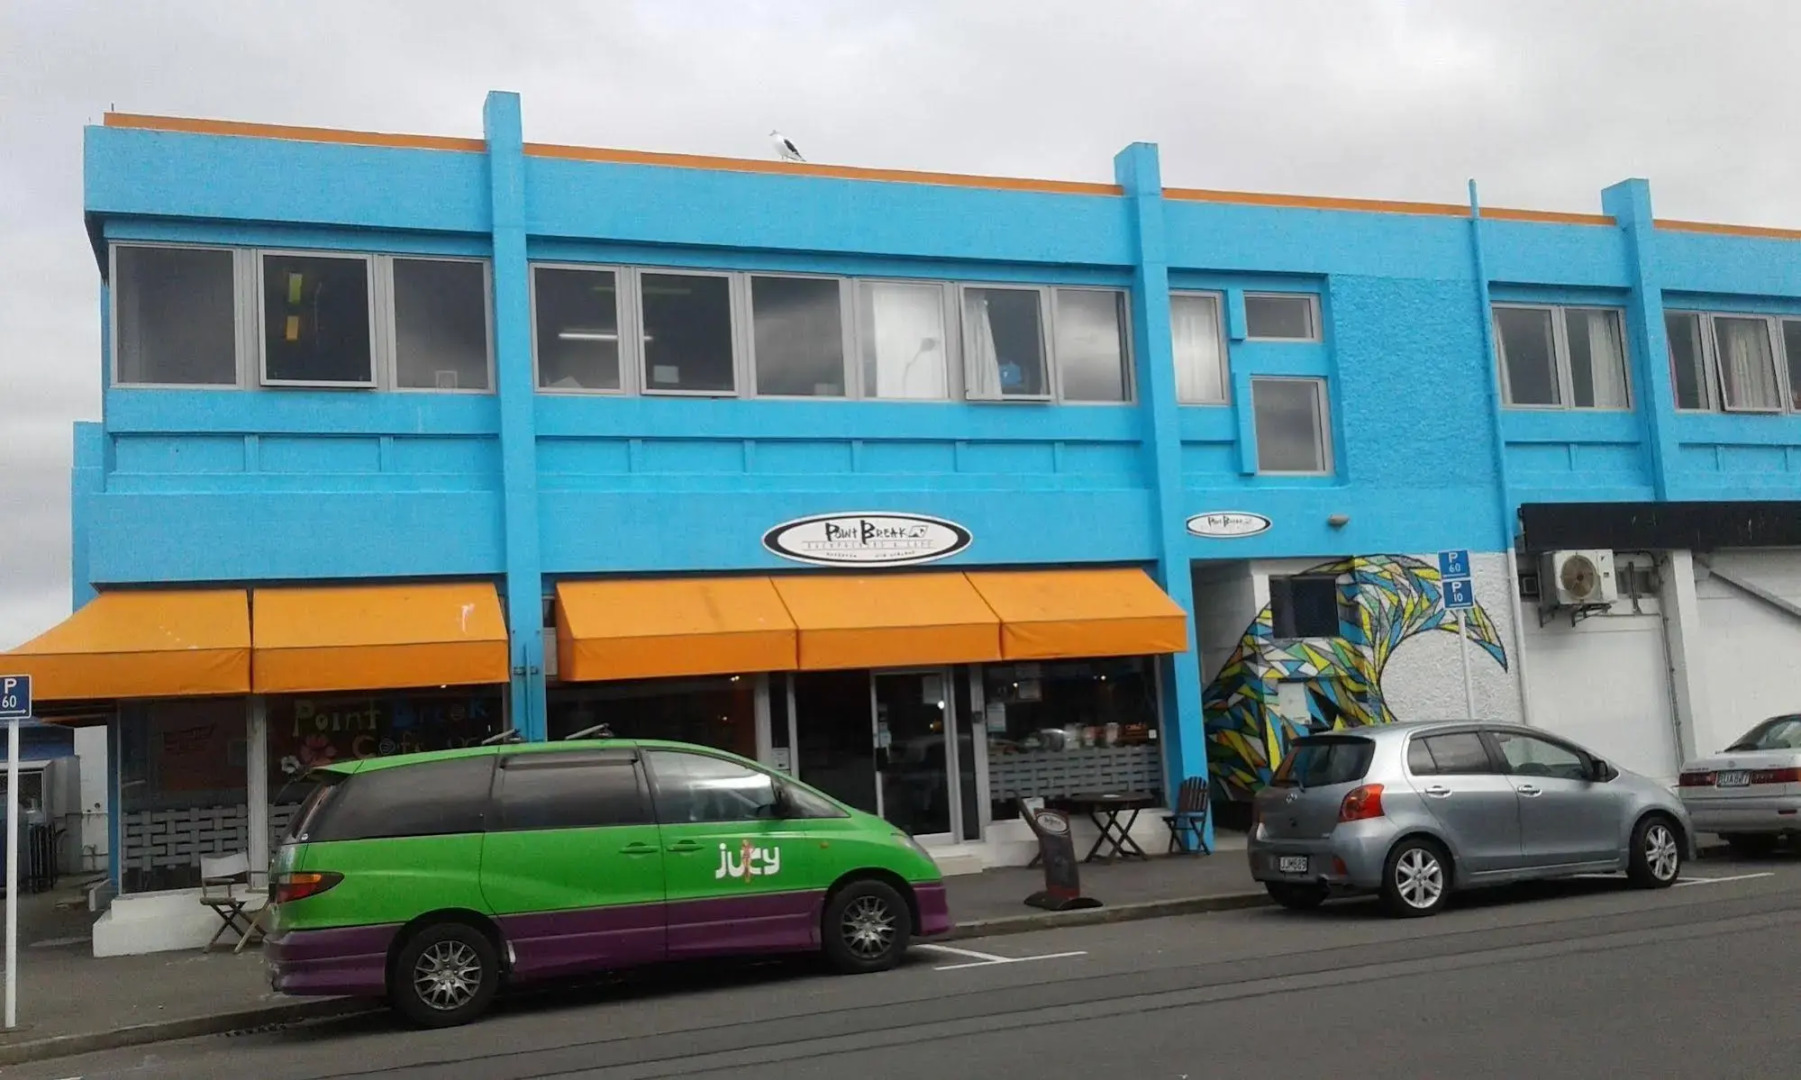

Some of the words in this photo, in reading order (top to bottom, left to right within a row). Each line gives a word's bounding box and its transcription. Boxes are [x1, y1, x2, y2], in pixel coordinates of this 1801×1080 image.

[1449, 552, 1458, 563] P
[1449, 562, 1461, 573] 60
[1452, 581, 1461, 593] P
[1453, 592, 1463, 602] 10
[4, 678, 17, 694] P
[2, 694, 17, 708] 60
